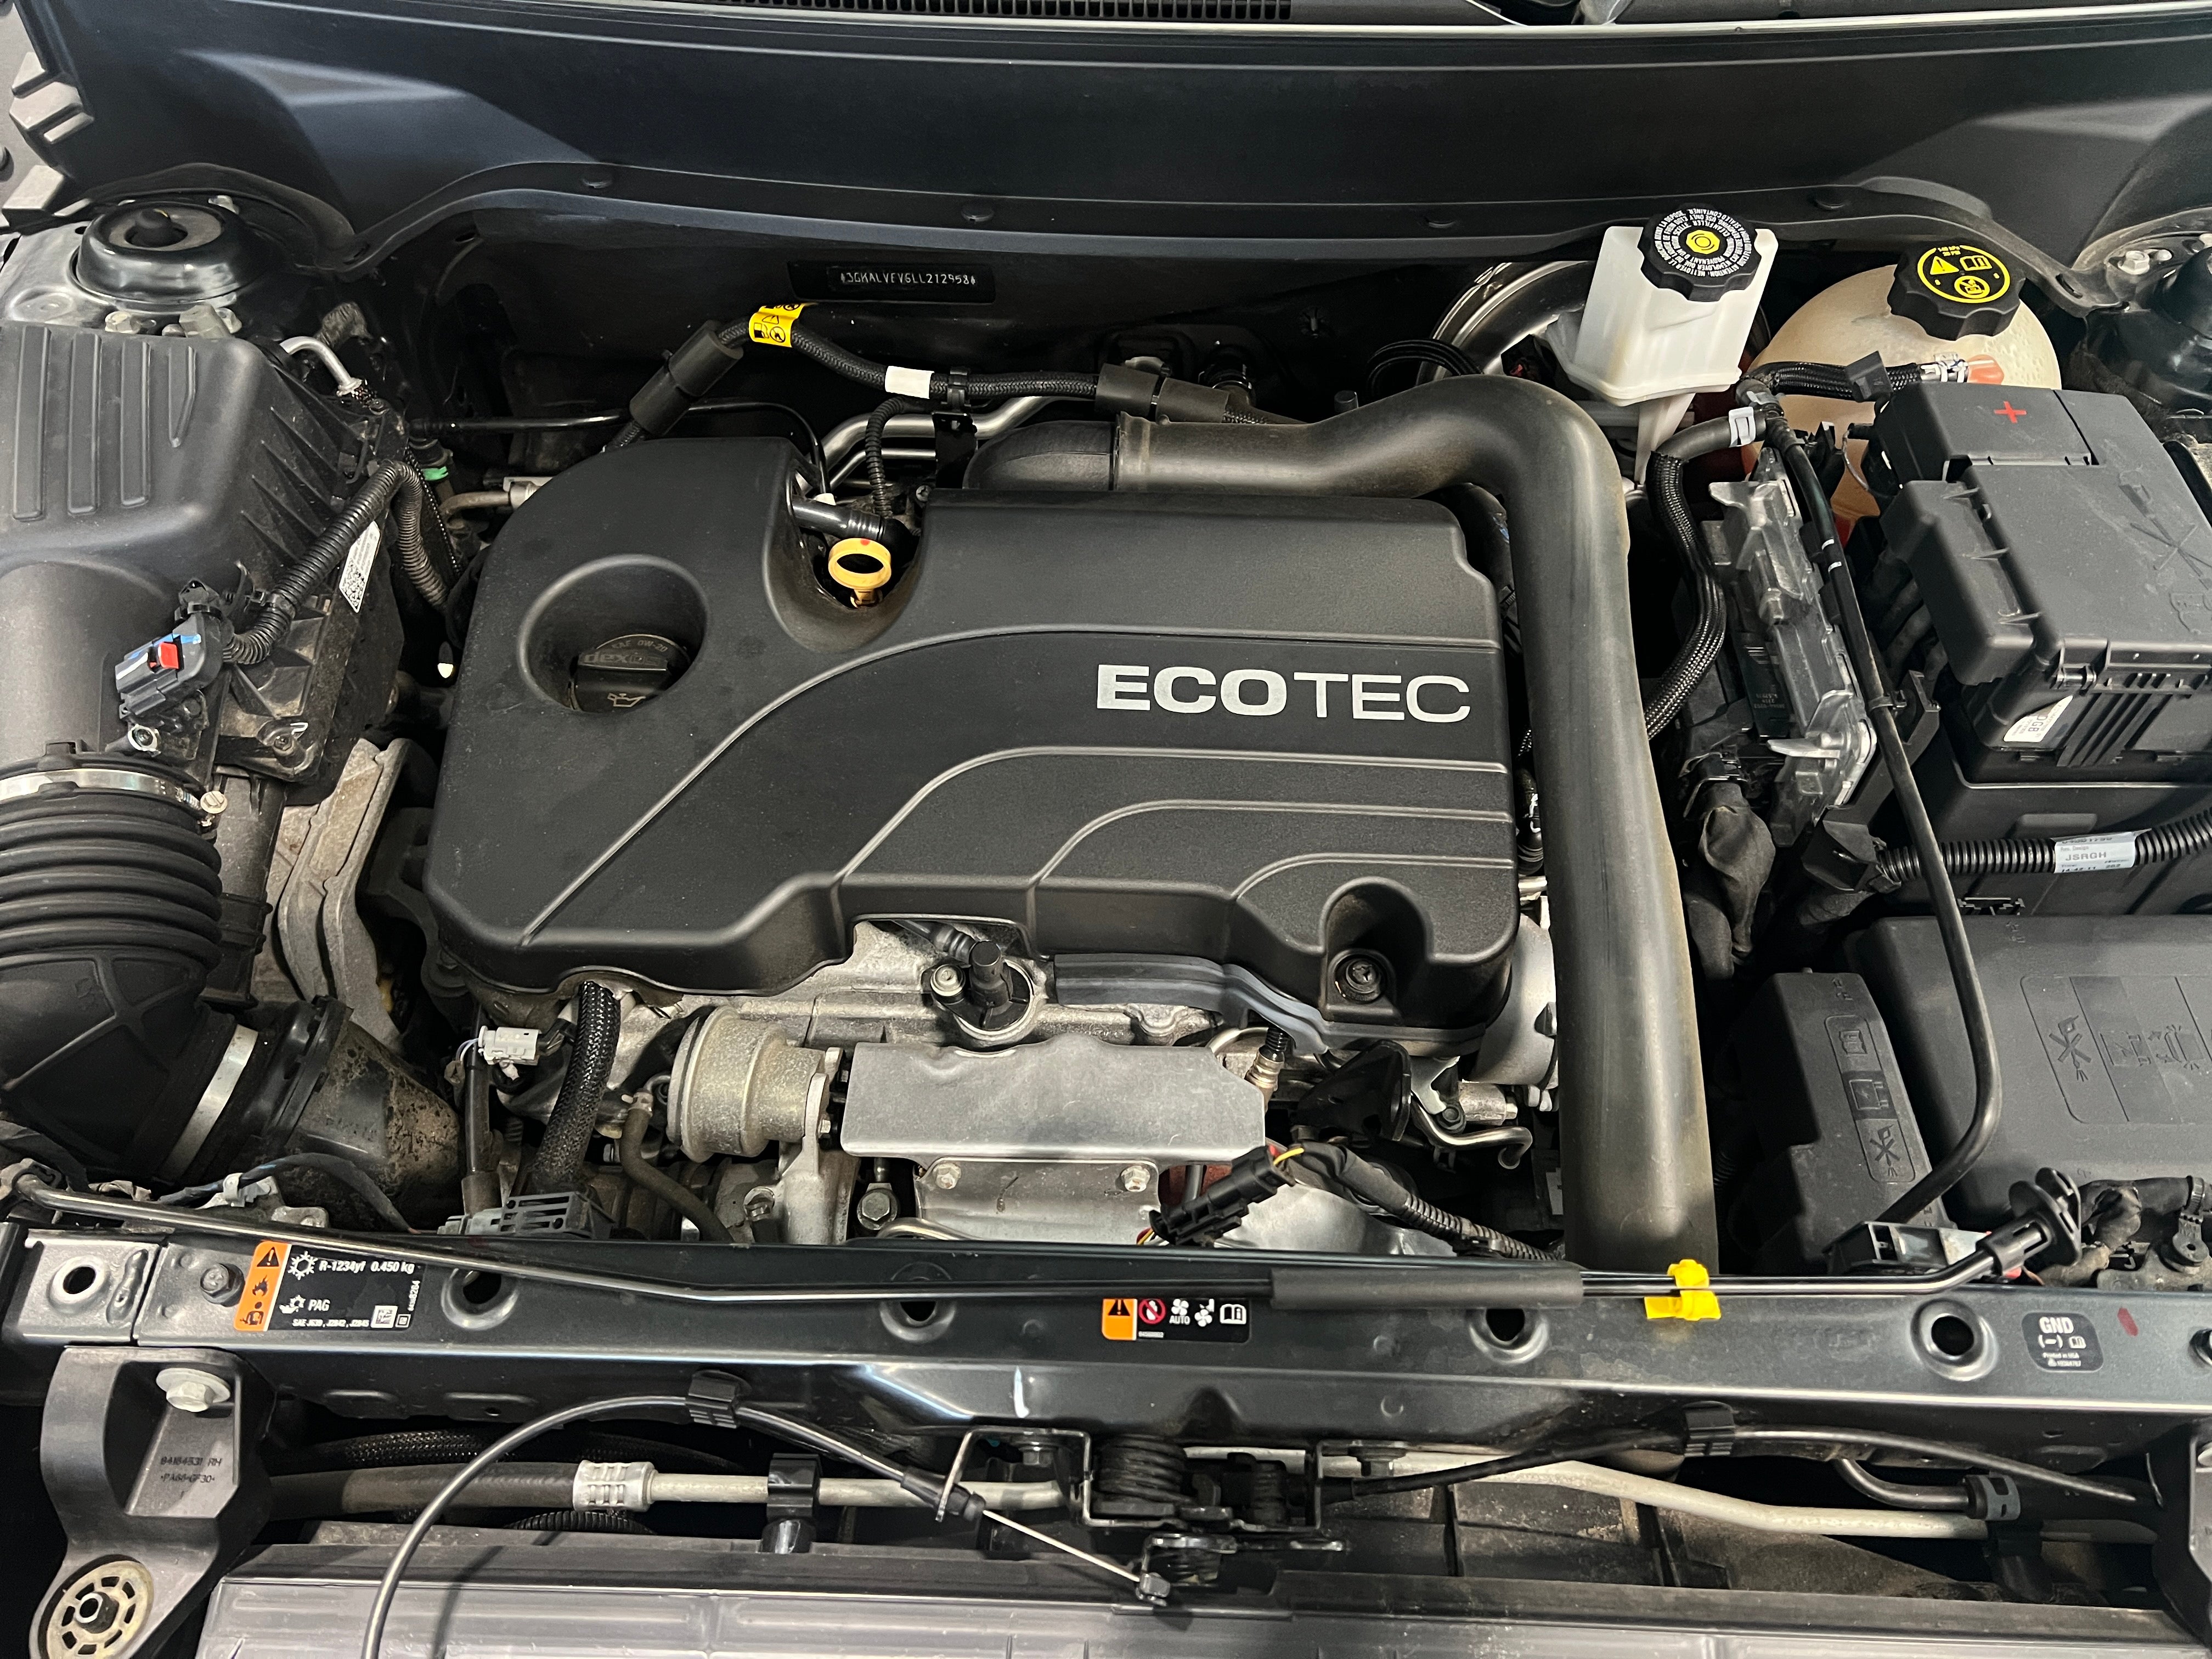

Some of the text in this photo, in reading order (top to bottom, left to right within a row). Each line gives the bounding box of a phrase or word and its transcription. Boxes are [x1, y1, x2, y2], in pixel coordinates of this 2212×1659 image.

[1705, 213, 1718, 222] USE
[1690, 219, 1714, 228] FILLER
[1712, 223, 1730, 236] CLEAN
[1675, 262, 1705, 276] NETTOYER
[1681, 259, 1696, 270] QUE
[1097, 664, 1471, 723] ECOTEC
[2066, 852, 2107, 861] JSRGH
[319, 1261, 415, 1274] R-1234yf 0.450 kg
[308, 1299, 330, 1311] PAG
[1170, 1316, 1190, 1325] AUTO
[2039, 1317, 2074, 1334] GND
[207, 1458, 222, 1467] RH
